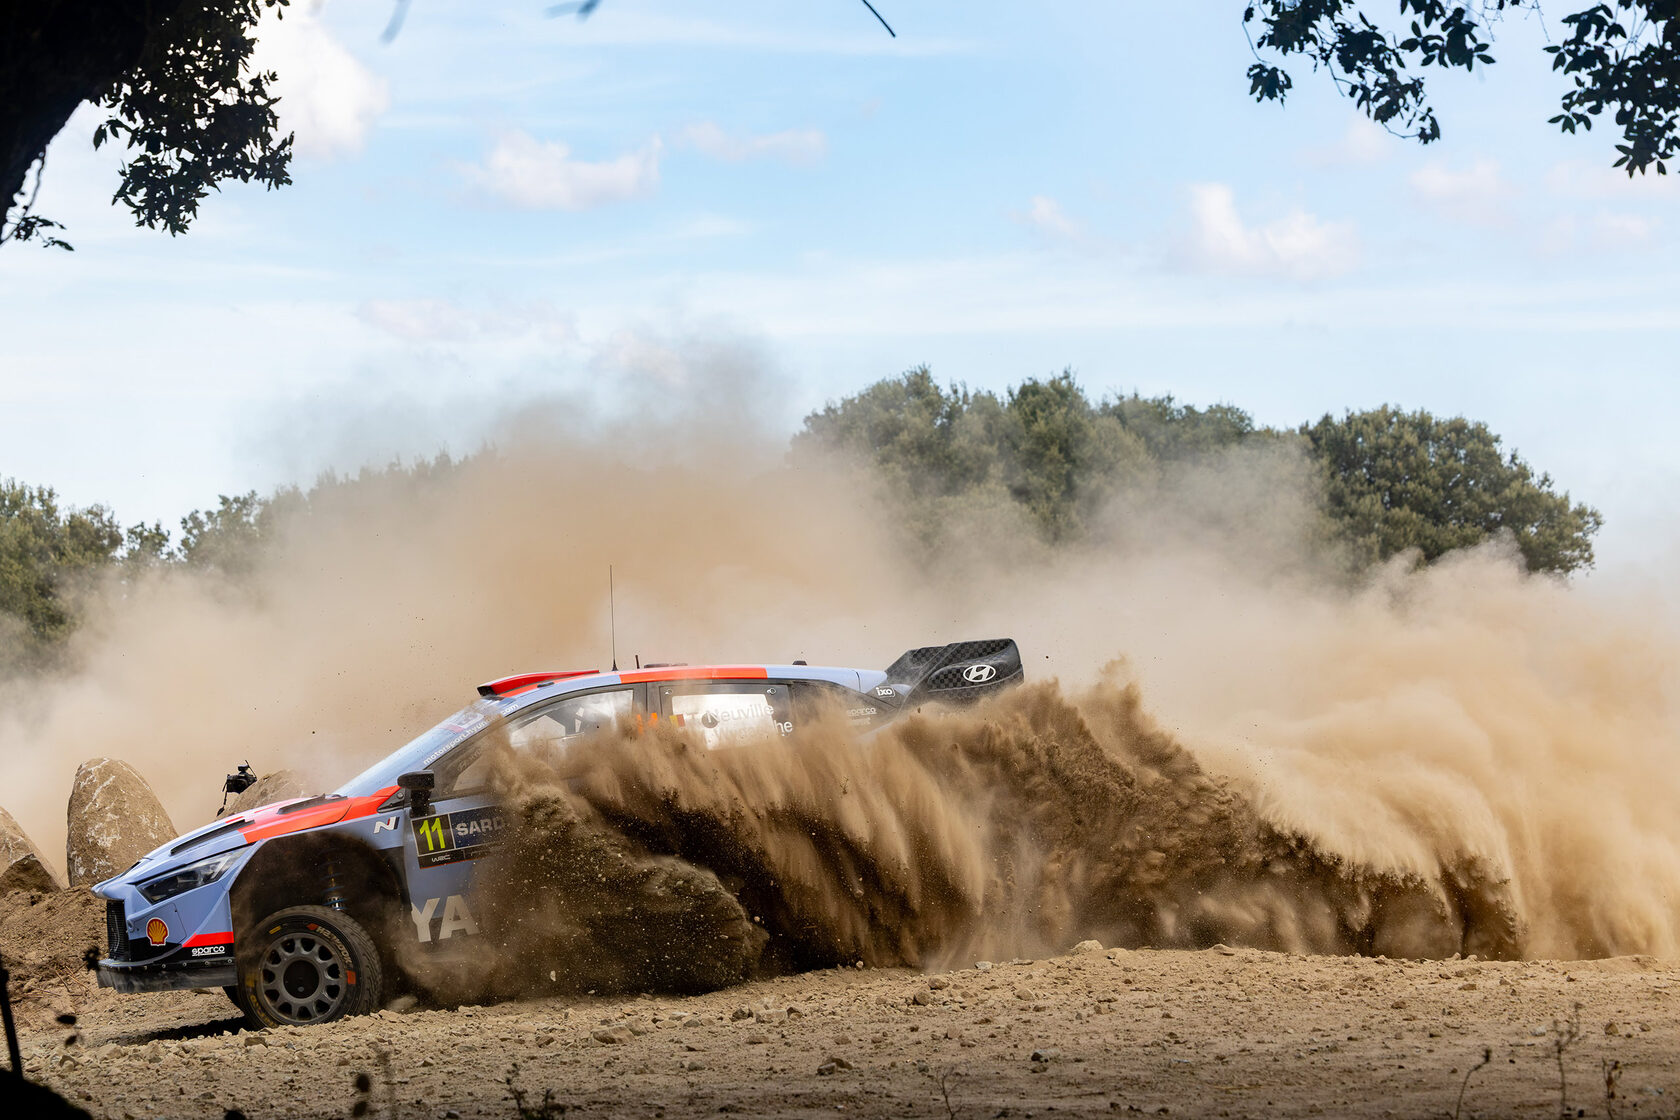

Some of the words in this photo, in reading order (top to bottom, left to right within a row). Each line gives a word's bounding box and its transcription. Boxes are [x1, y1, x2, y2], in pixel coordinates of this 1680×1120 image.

[706, 703, 776, 723] Neuville
[419, 817, 446, 851] 11
[431, 854, 451, 863] WRC
[191, 945, 225, 957] sparco
